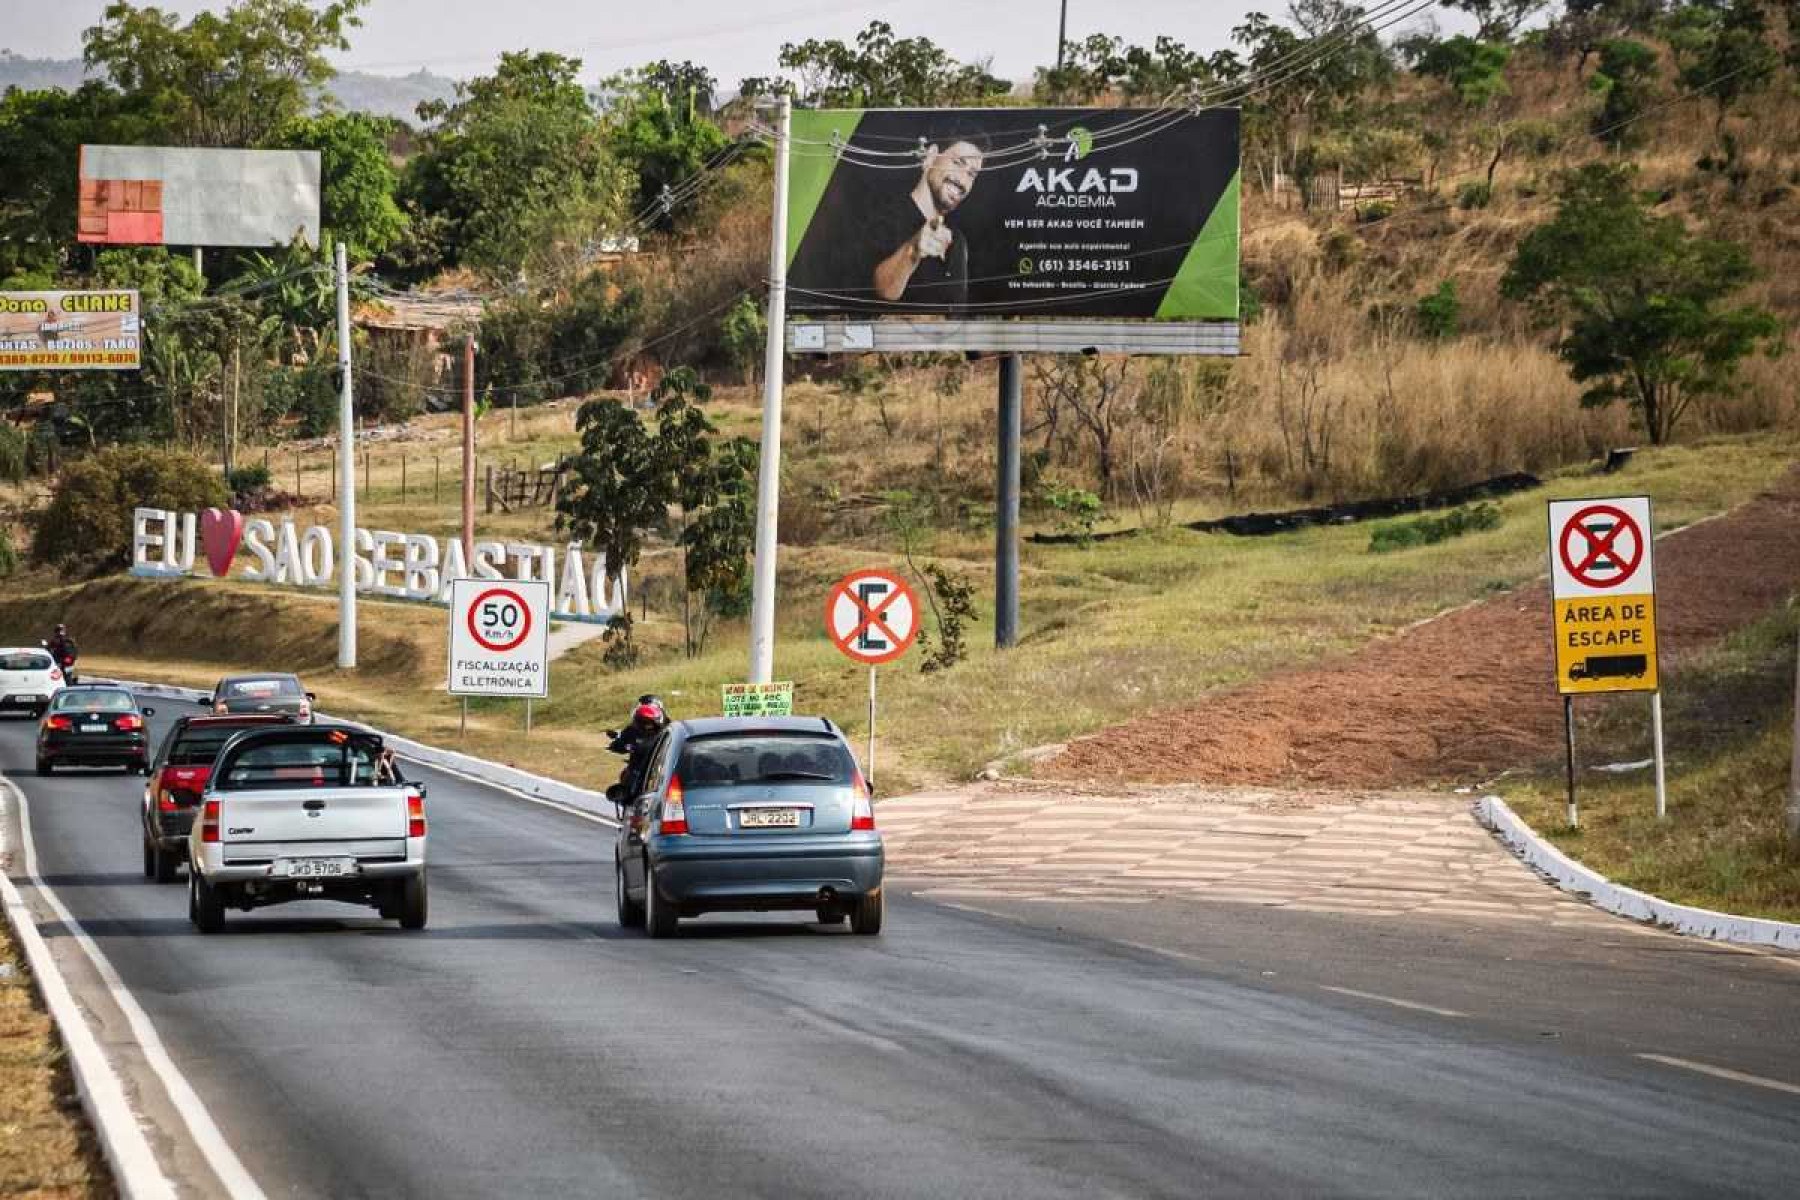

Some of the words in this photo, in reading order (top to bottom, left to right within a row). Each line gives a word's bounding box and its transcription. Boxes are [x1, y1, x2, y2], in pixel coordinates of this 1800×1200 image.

[1015, 167, 1139, 193] AKAD
[1035, 195, 1116, 208] ACADEMIA
[1004, 219, 1024, 229] VEM
[1026, 219, 1045, 229] SER
[1046, 219, 1073, 229] AKAD
[1076, 217, 1102, 229] VOCÊ
[1105, 217, 1144, 229] TAMBÉM
[1038, 259, 1063, 273] (61)
[1067, 260, 1130, 271] 3546-3151
[60, 294, 131, 312] ELIANE
[134, 507, 196, 573] EU
[241, 511, 334, 587] SÃO
[482, 603, 518, 628] 50
[1565, 602, 1615, 623] ÁREA
[1621, 603, 1646, 621] DE
[484, 629, 514, 639] Km/h
[1568, 628, 1643, 648] ESCAPE
[456, 659, 540, 674] FISCALIZAÇÃO
